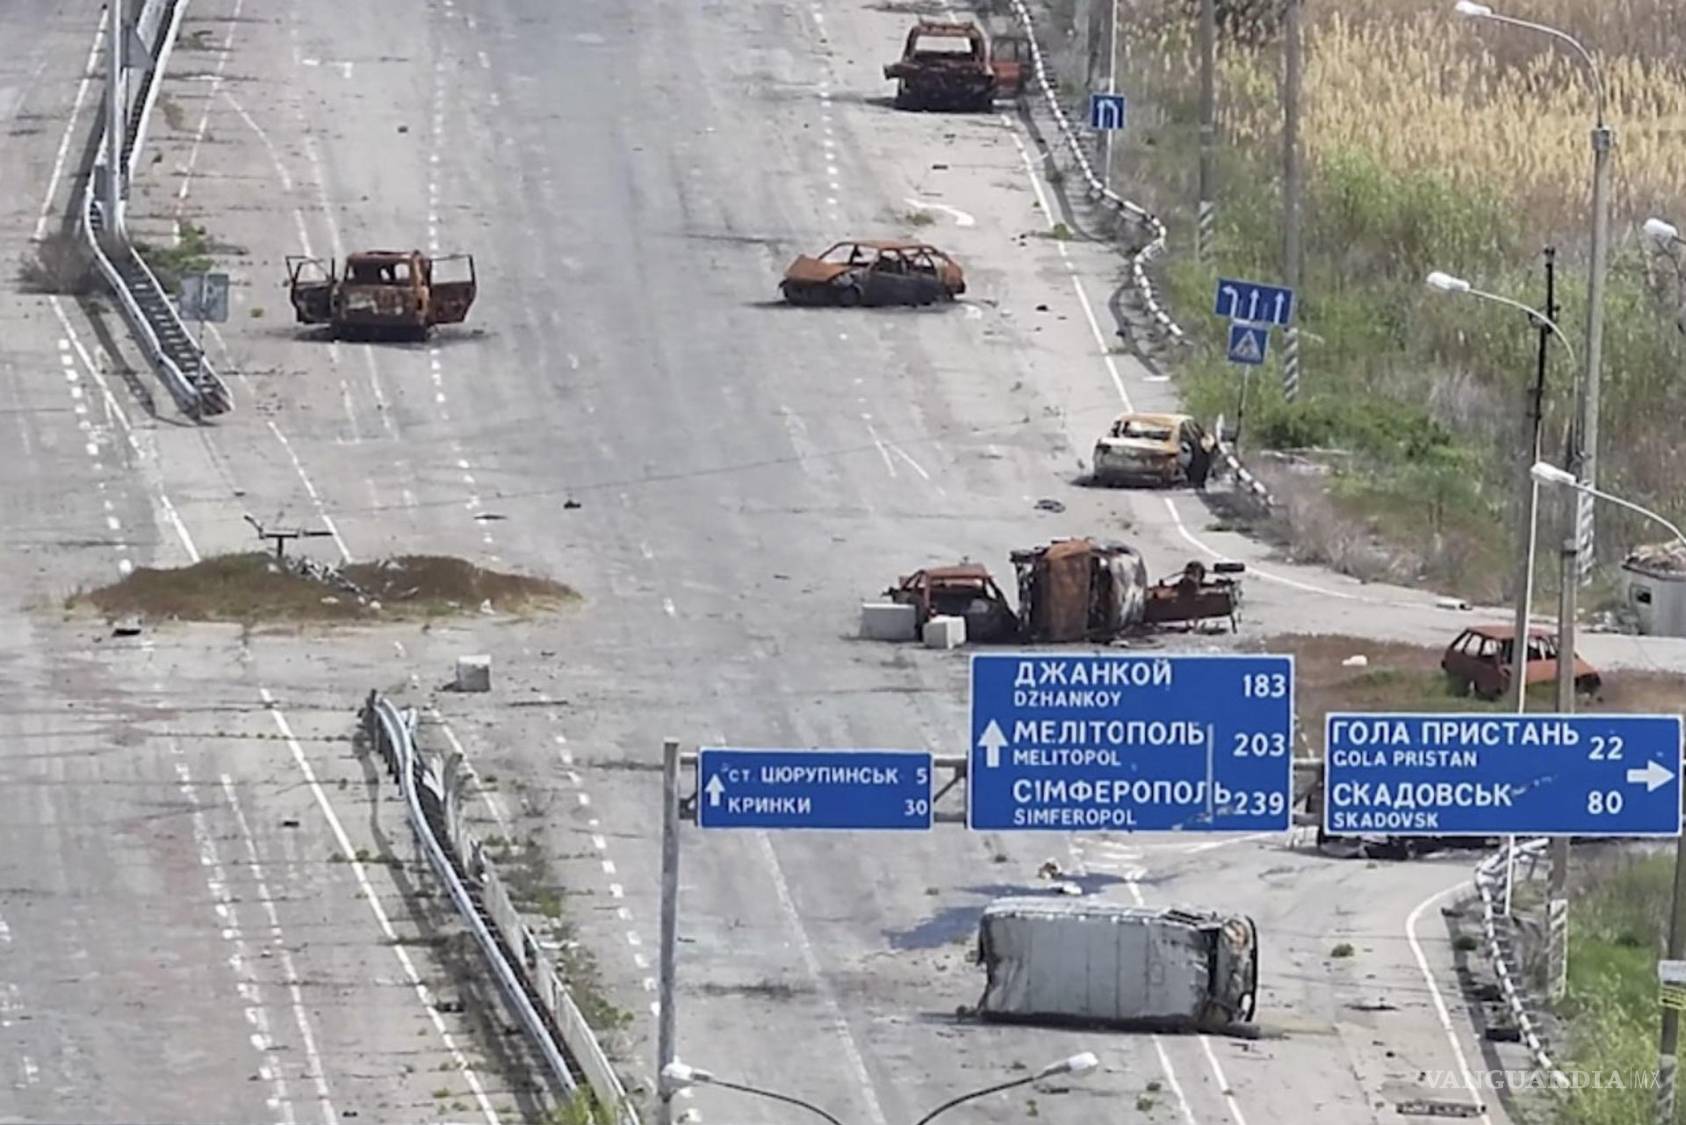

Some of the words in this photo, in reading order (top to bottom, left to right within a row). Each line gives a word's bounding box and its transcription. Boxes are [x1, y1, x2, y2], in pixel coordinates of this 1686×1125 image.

[1014, 659, 1173, 687] ДЖАНКОЙ
[1244, 674, 1285, 697] 183
[1015, 691, 1120, 707] DZHANKOY
[1014, 721, 1204, 745] МЕЛІТОПОЛЬ
[1333, 721, 1409, 745] ГОЛА
[1423, 722, 1578, 745] ПРИСТАНЬ
[1234, 733, 1284, 756] 203
[1589, 737, 1623, 759] 22
[1014, 749, 1120, 765] MELITOPOL
[1333, 750, 1386, 766] GOLA
[1394, 751, 1476, 766] PRISTAN
[762, 767, 897, 783] ЦЮРУПИНСЬК
[916, 767, 928, 784] 5
[729, 798, 810, 813] КРИНКИ
[904, 799, 928, 816] 30
[1234, 792, 1284, 815] 239
[1332, 783, 1512, 809] СКАДОВСЬК
[1588, 791, 1622, 814] 80
[1014, 809, 1136, 825] SIMFEROPOL
[1334, 812, 1437, 828] SKADOVSK
